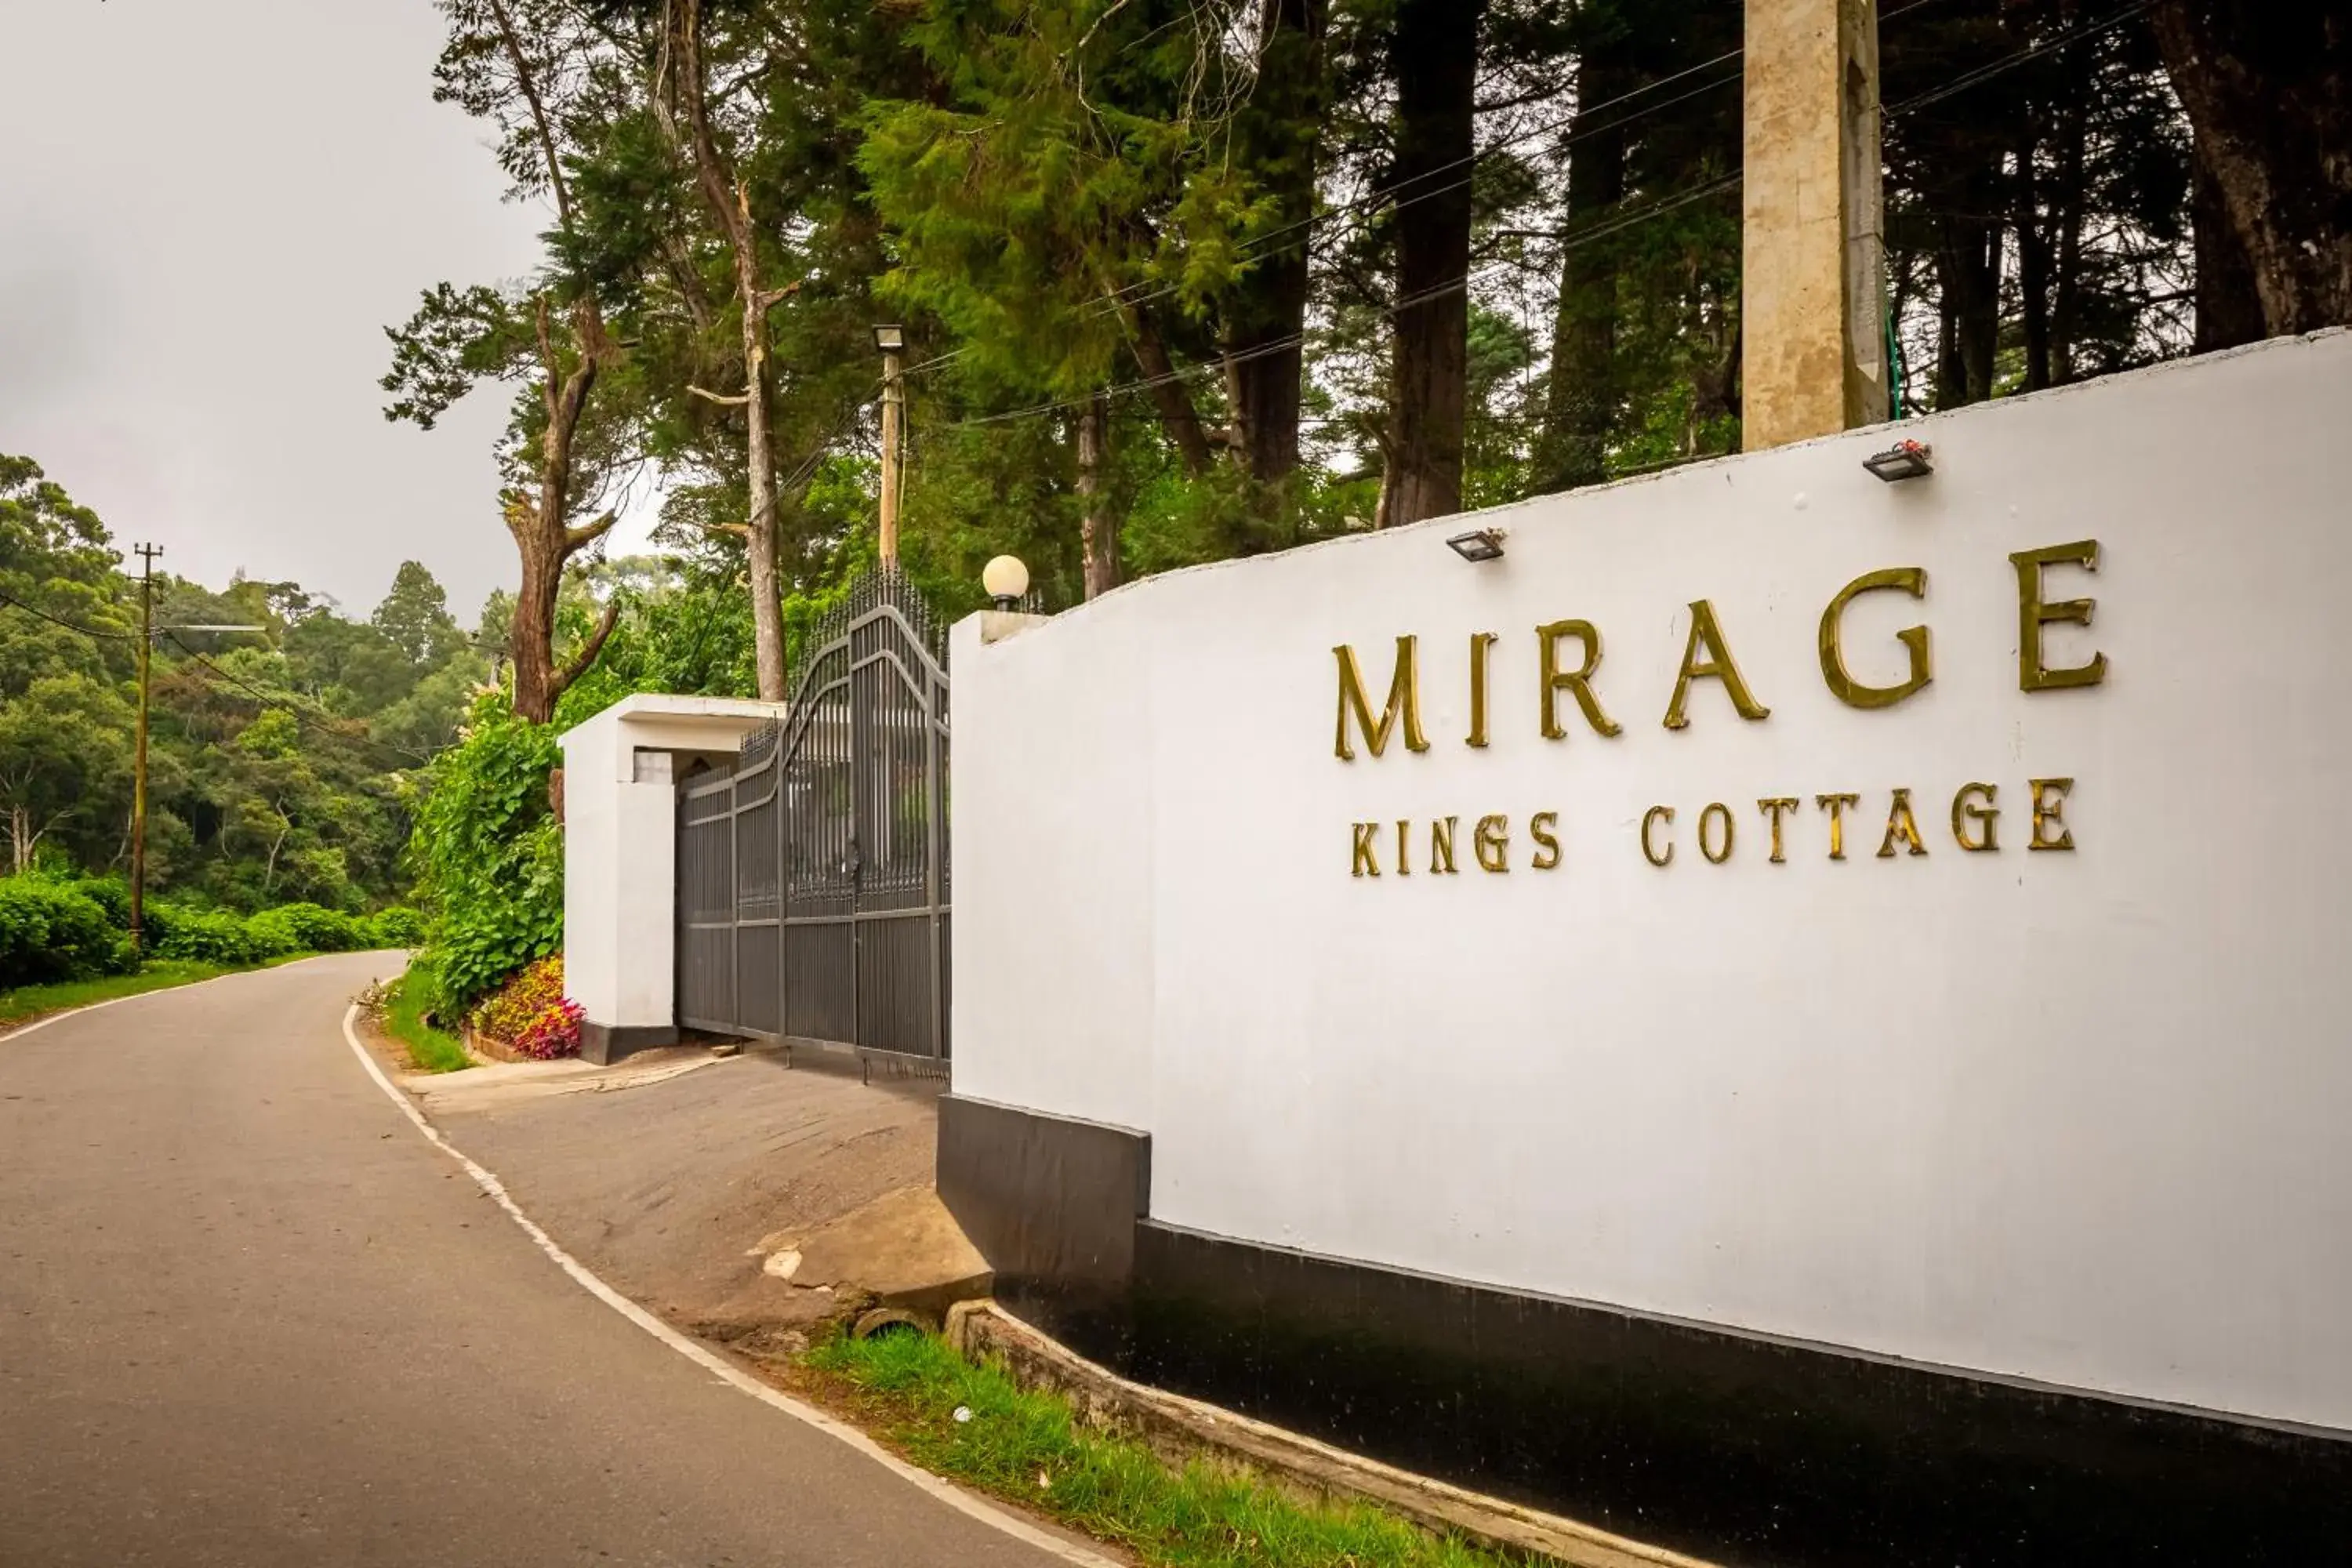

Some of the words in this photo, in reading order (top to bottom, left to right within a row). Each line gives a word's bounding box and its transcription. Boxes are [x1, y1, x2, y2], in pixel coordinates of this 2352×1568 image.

[1332, 539, 2108, 762] MIRAGE
[1351, 811, 1562, 877] KINGS
[1641, 777, 2075, 867] COTTAGE
